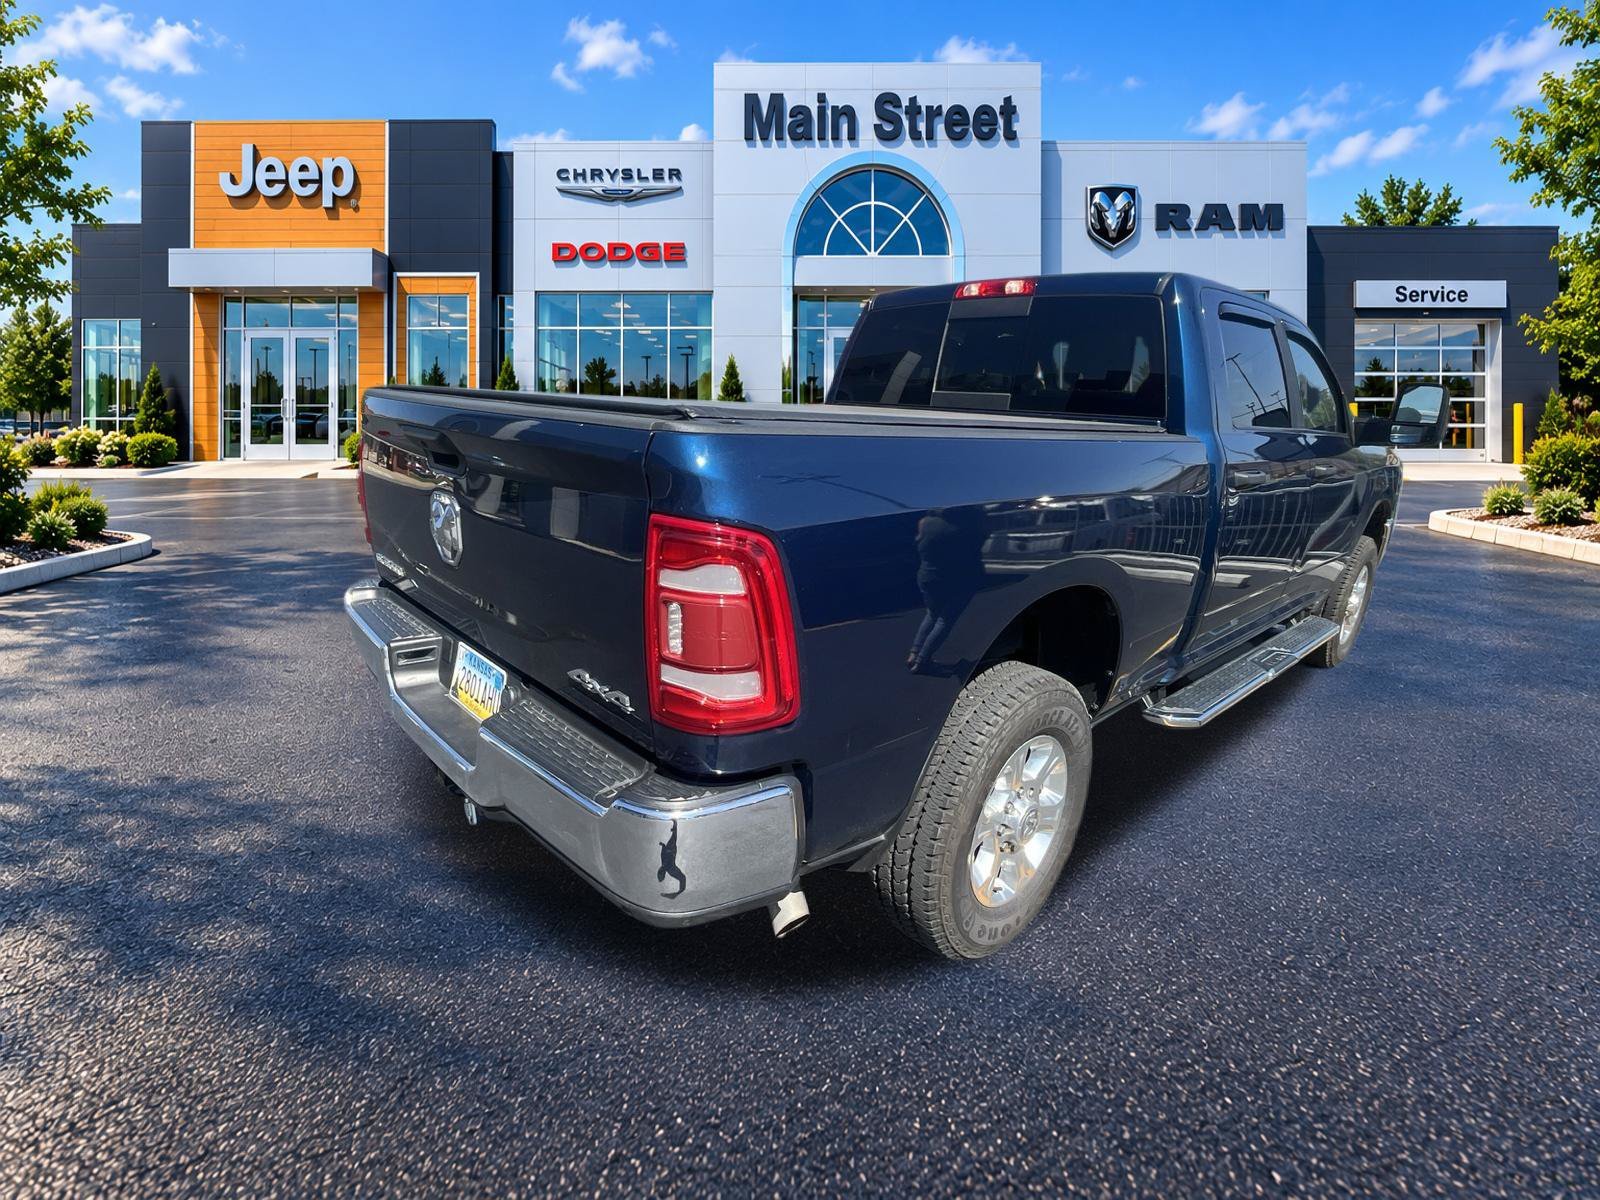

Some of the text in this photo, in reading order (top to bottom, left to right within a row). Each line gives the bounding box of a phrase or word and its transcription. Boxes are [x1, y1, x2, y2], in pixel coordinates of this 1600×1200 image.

[744, 92, 1018, 141] Main Street
[219, 143, 355, 208] Jeep
[556, 168, 682, 183] CHRYSLER
[1155, 203, 1284, 232] RAM
[551, 242, 686, 262] DODGE
[1396, 285, 1468, 304] Service
[468, 653, 493, 680] KANSAS
